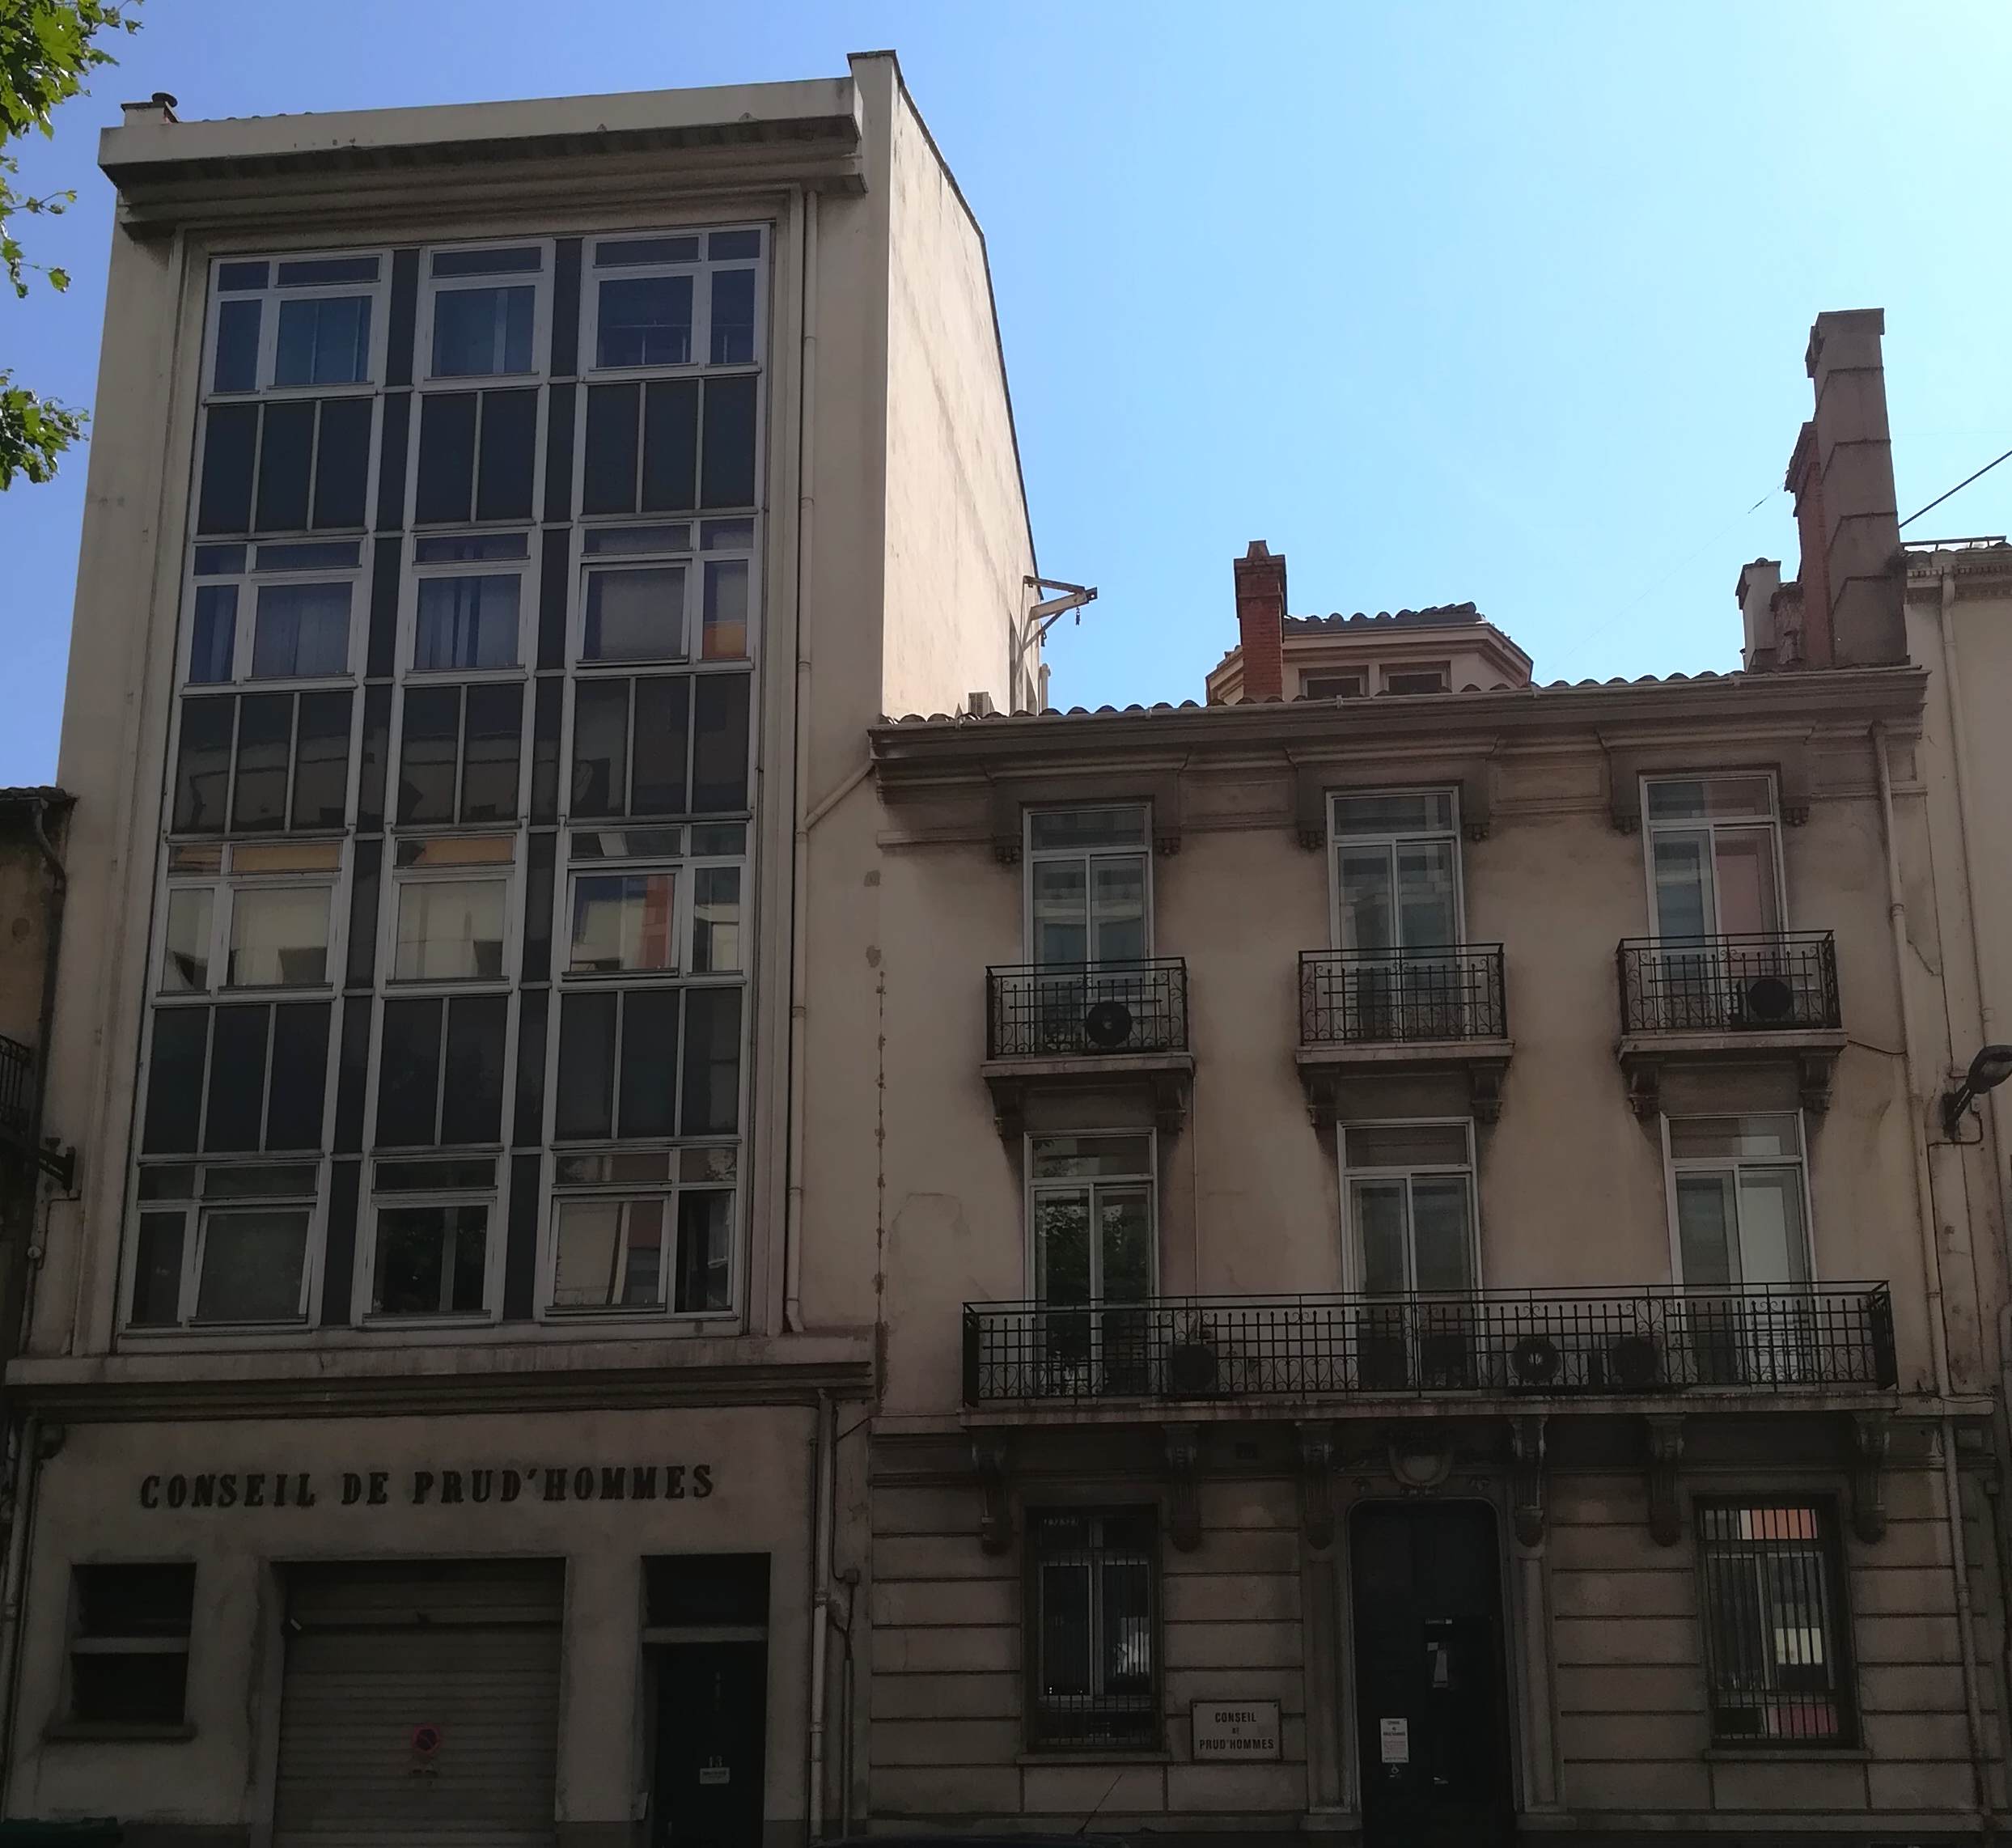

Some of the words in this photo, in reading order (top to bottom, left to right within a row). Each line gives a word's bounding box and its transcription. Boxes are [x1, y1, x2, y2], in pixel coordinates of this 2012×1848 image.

[140, 1473, 316, 1509] CONSEIL
[341, 1472, 390, 1506] DE
[412, 1464, 714, 1505] PRUD'HOMMES
[1215, 1712, 1257, 1723] CONSEIL
